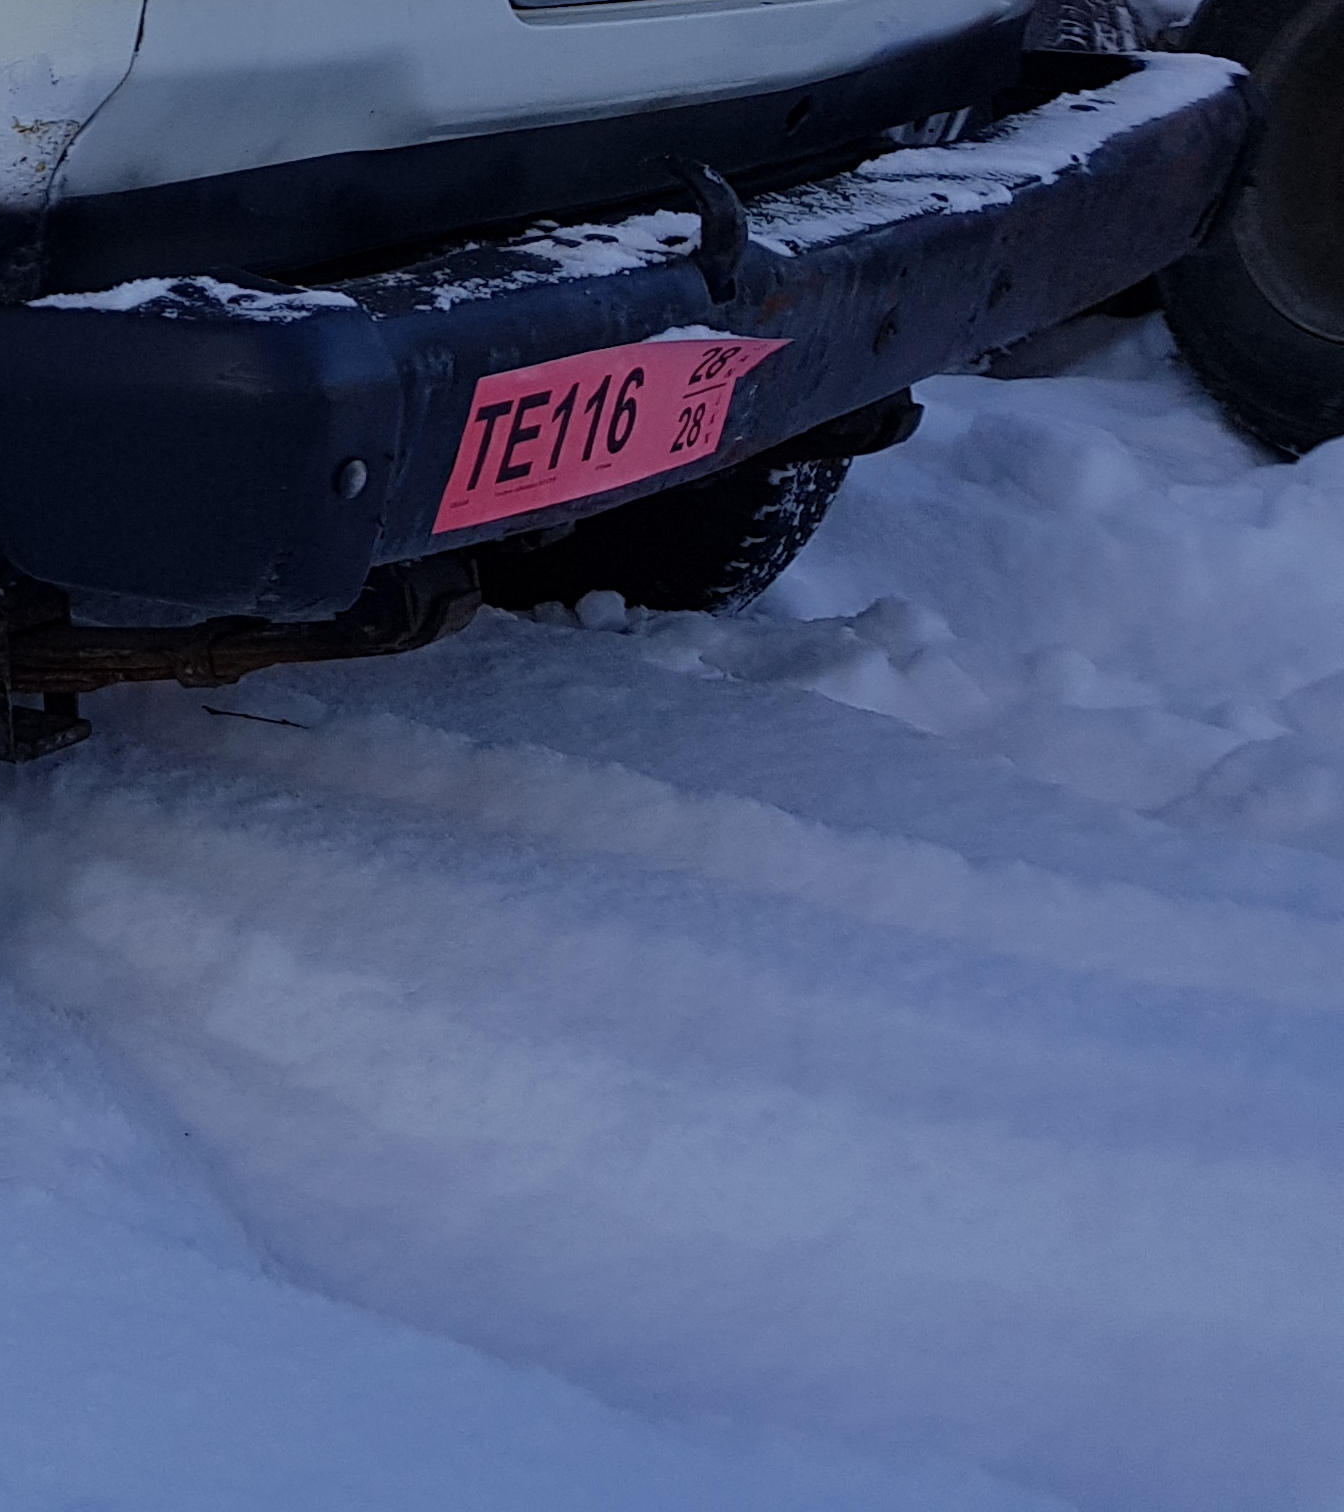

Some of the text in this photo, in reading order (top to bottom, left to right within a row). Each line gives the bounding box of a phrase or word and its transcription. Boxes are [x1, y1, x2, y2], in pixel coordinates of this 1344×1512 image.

[688, 346, 742, 386] 28
[466, 366, 645, 492] TE116
[669, 402, 706, 454] 28
